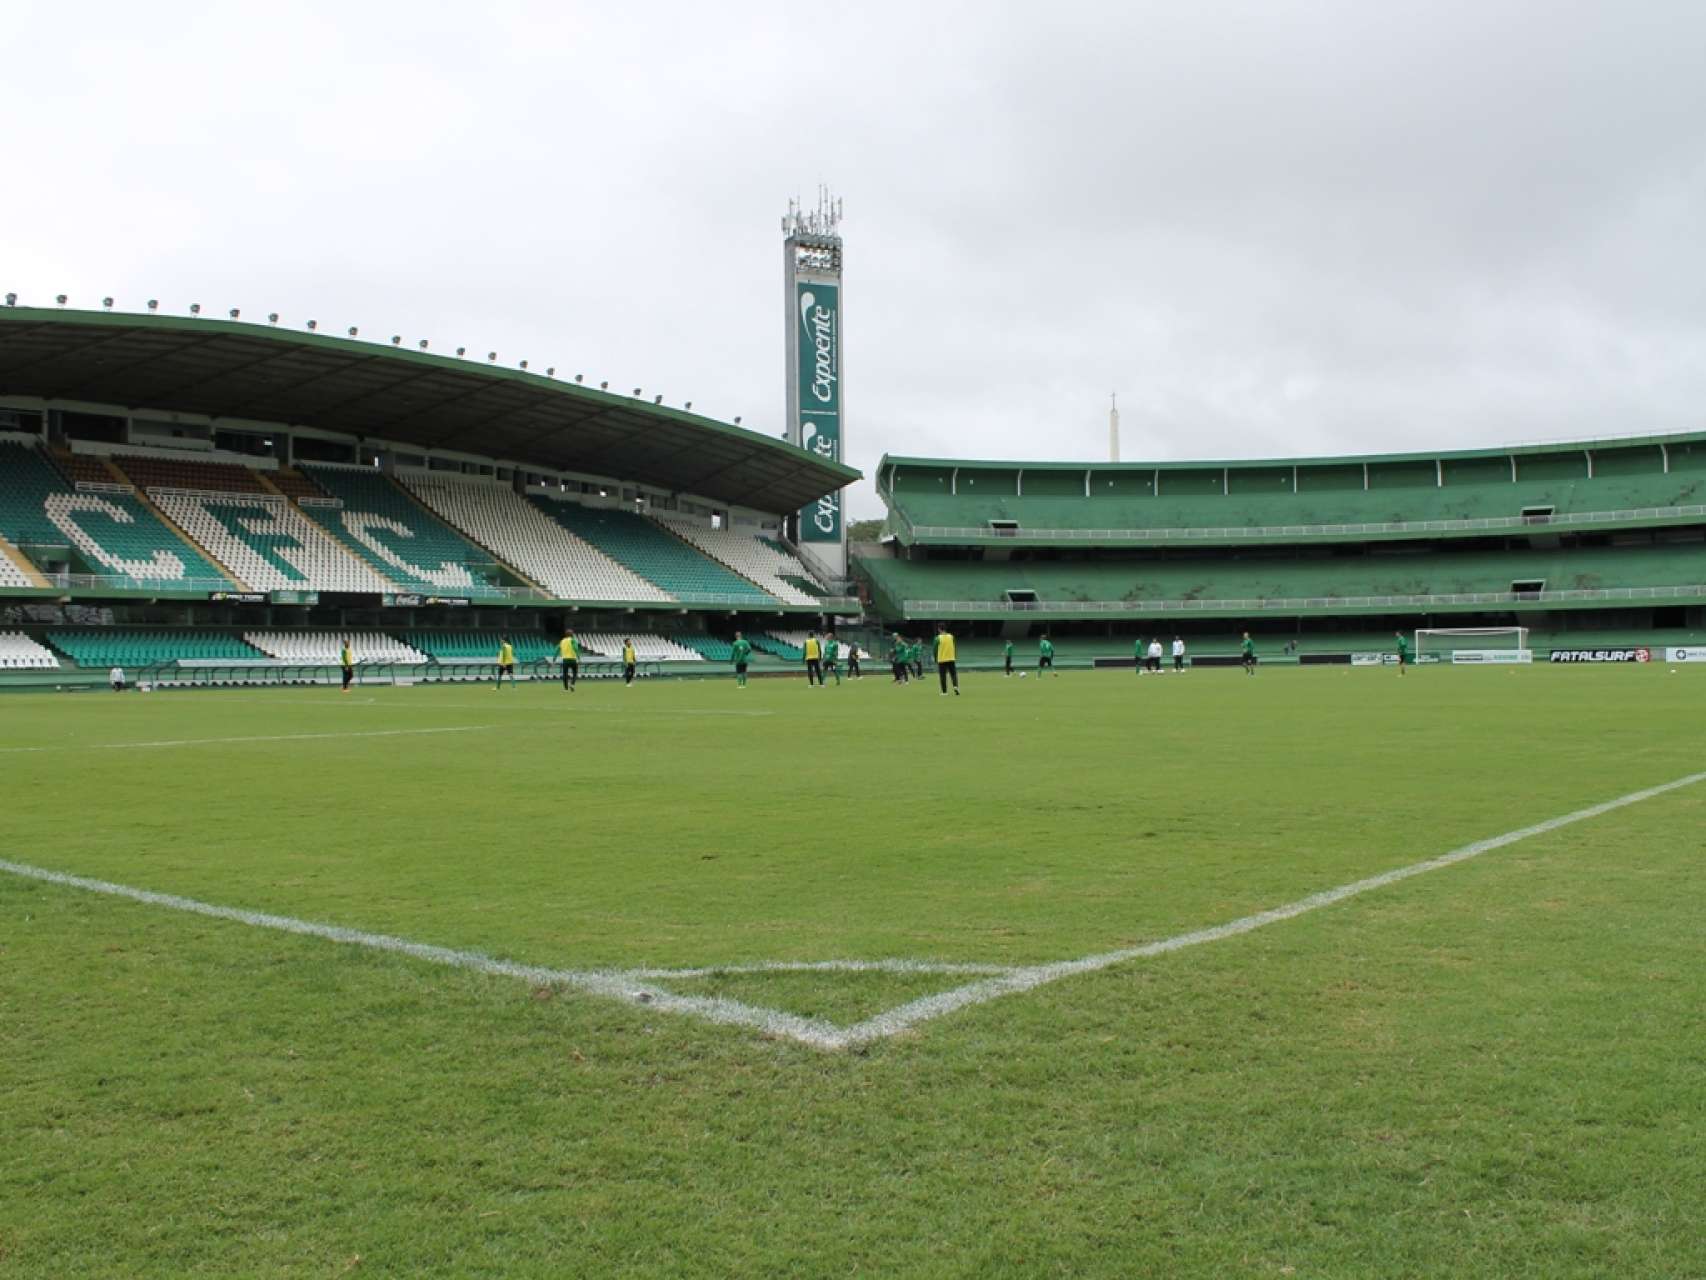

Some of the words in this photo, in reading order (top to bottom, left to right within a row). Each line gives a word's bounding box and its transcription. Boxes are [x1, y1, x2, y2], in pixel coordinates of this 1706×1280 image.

[812, 304, 836, 402] Expoente
[814, 434, 839, 533] Expte
[1551, 651, 1635, 662] FATALSURF
